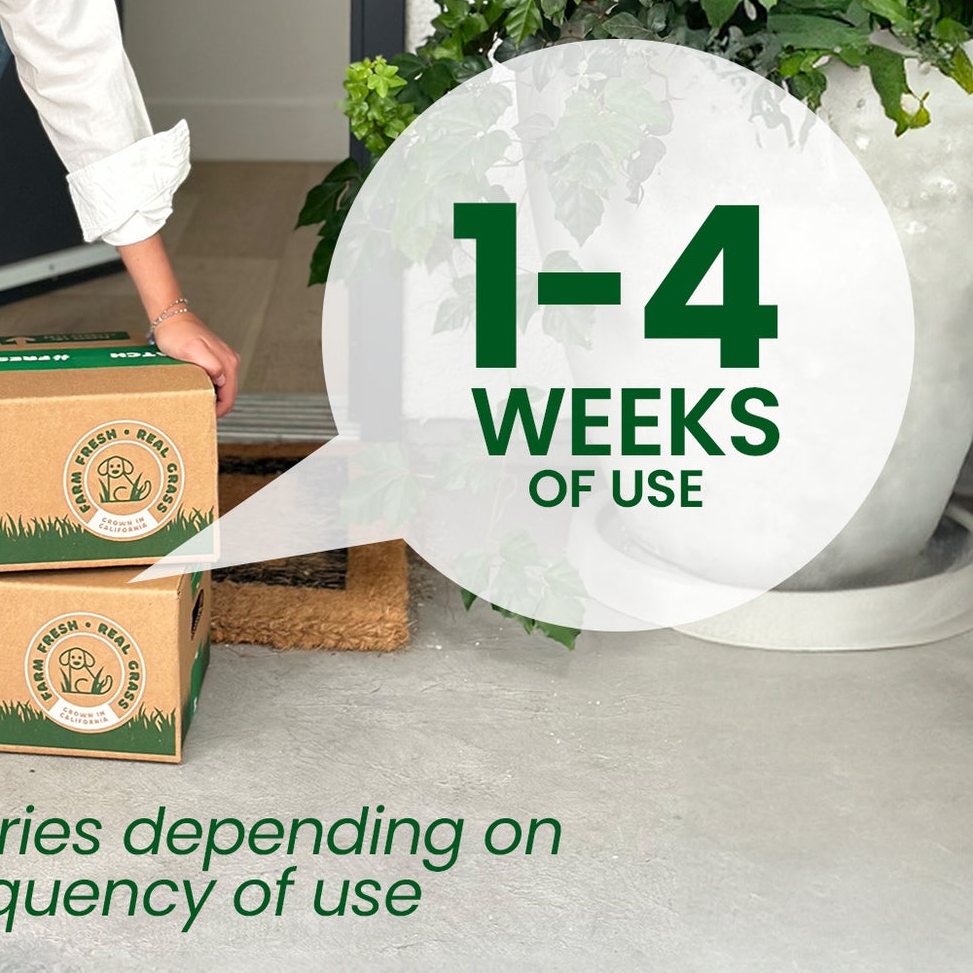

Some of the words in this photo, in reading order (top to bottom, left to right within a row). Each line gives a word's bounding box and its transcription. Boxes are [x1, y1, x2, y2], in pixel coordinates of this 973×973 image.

[75, 429, 117, 466] FRESH
[136, 429, 170, 459] REAL
[71, 472, 91, 513] FARM
[157, 463, 179, 513] GRASS
[37, 620, 79, 653] FRESH
[97, 622, 130, 656] REAL
[33, 659, 52, 701] FARM
[118, 660, 140, 710] GRASS
